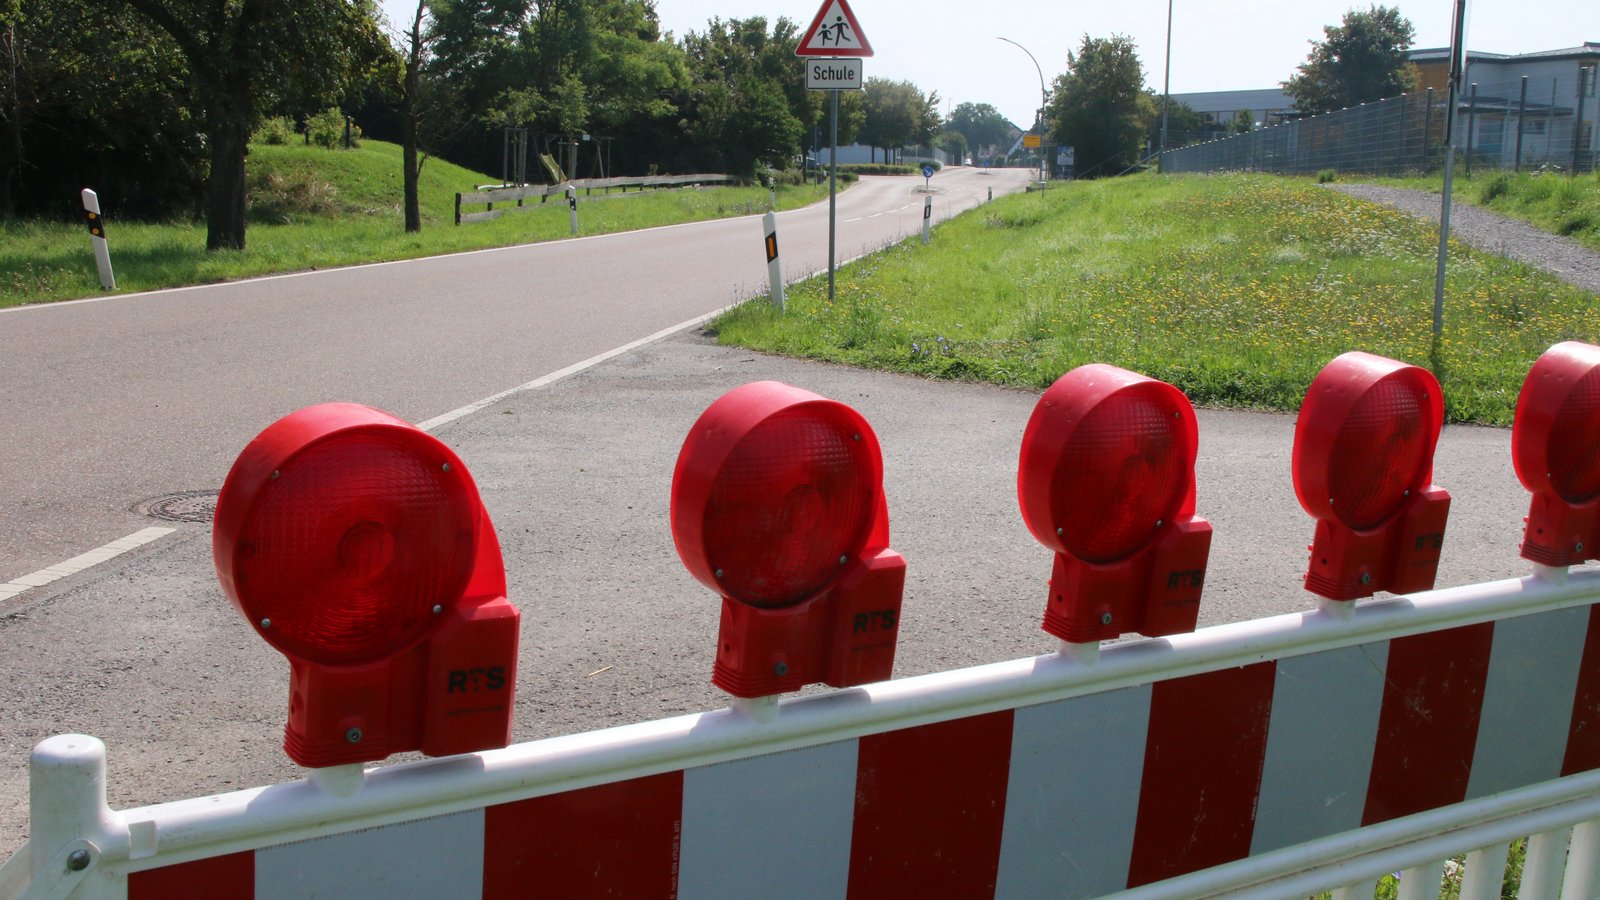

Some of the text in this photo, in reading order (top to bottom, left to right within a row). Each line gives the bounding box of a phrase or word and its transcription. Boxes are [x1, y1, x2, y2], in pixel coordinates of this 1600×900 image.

[813, 65, 854, 80] Schule
[853, 609, 896, 635] RTS
[447, 665, 506, 694] RTS
